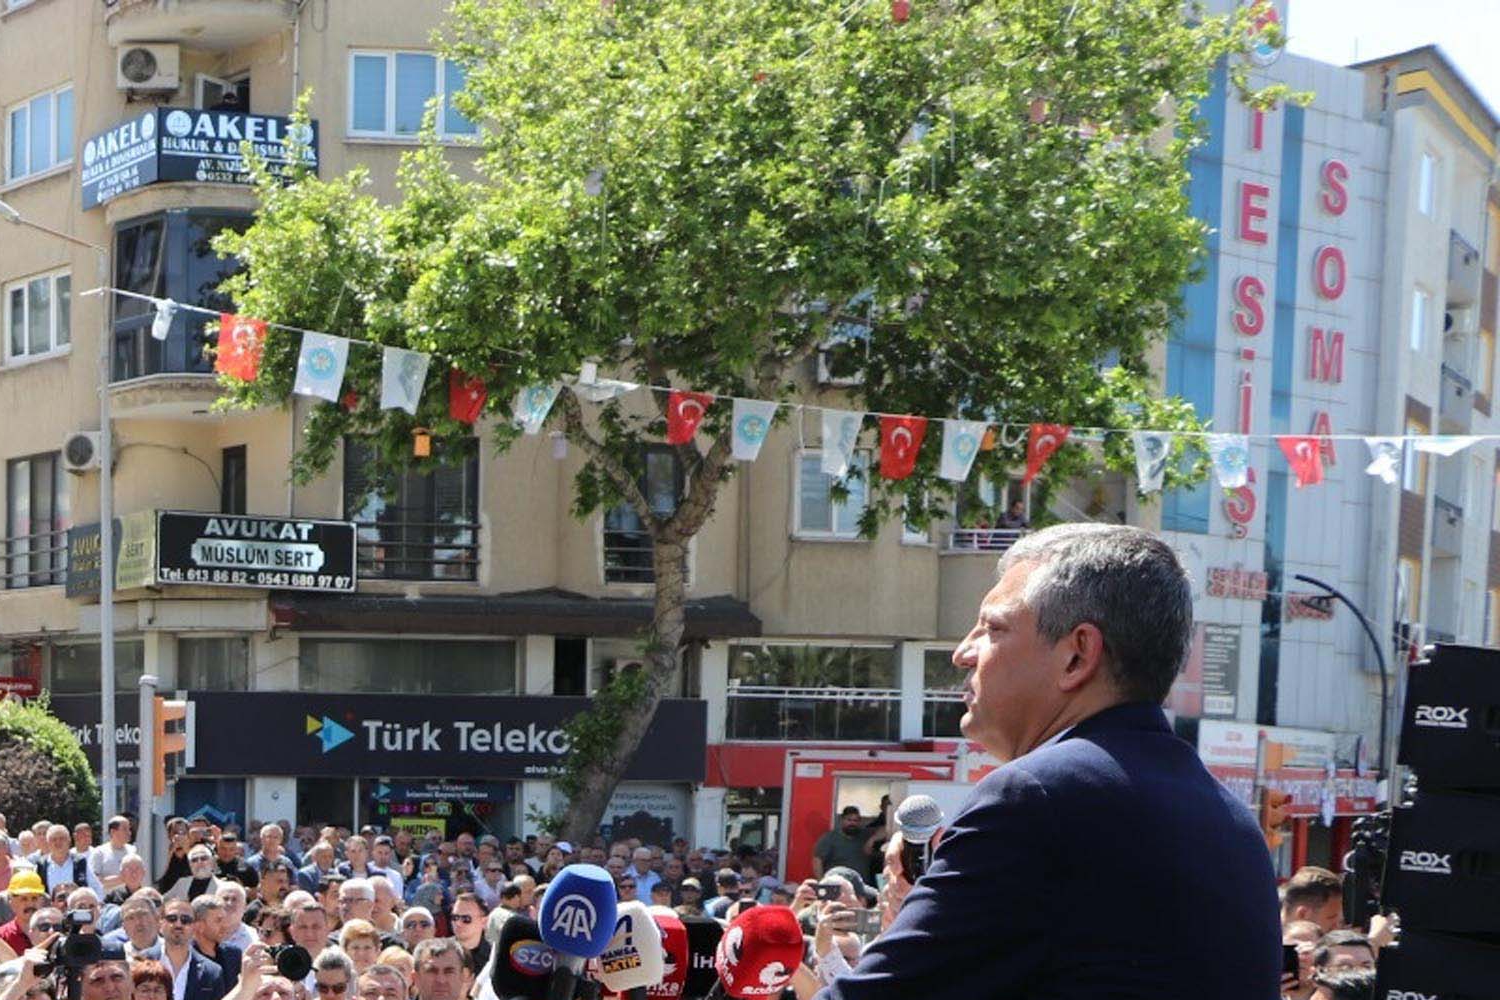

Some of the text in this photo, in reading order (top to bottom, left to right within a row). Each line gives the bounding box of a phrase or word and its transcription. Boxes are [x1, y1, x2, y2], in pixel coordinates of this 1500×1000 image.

[193, 113, 284, 142] AKEL
[97, 121, 141, 160] AKEL
[162, 136, 210, 152] HUKUK
[214, 141, 224, 152] &
[204, 519, 315, 541] AVUKAT
[201, 544, 315, 567] MÜSLÜM SERT
[161, 568, 184, 580] Tel:
[187, 568, 210, 582] 613
[213, 569, 230, 583] 86
[232, 571, 248, 583] 82
[258, 572, 290, 586] 0543
[318, 575, 333, 589] 97
[335, 576, 352, 590] 07
[1415, 705, 1469, 722] ROX
[362, 720, 580, 754] Türk Teleko
[1400, 850, 1451, 868] ROX
[551, 904, 593, 942] AA
[693, 952, 717, 969] İH
